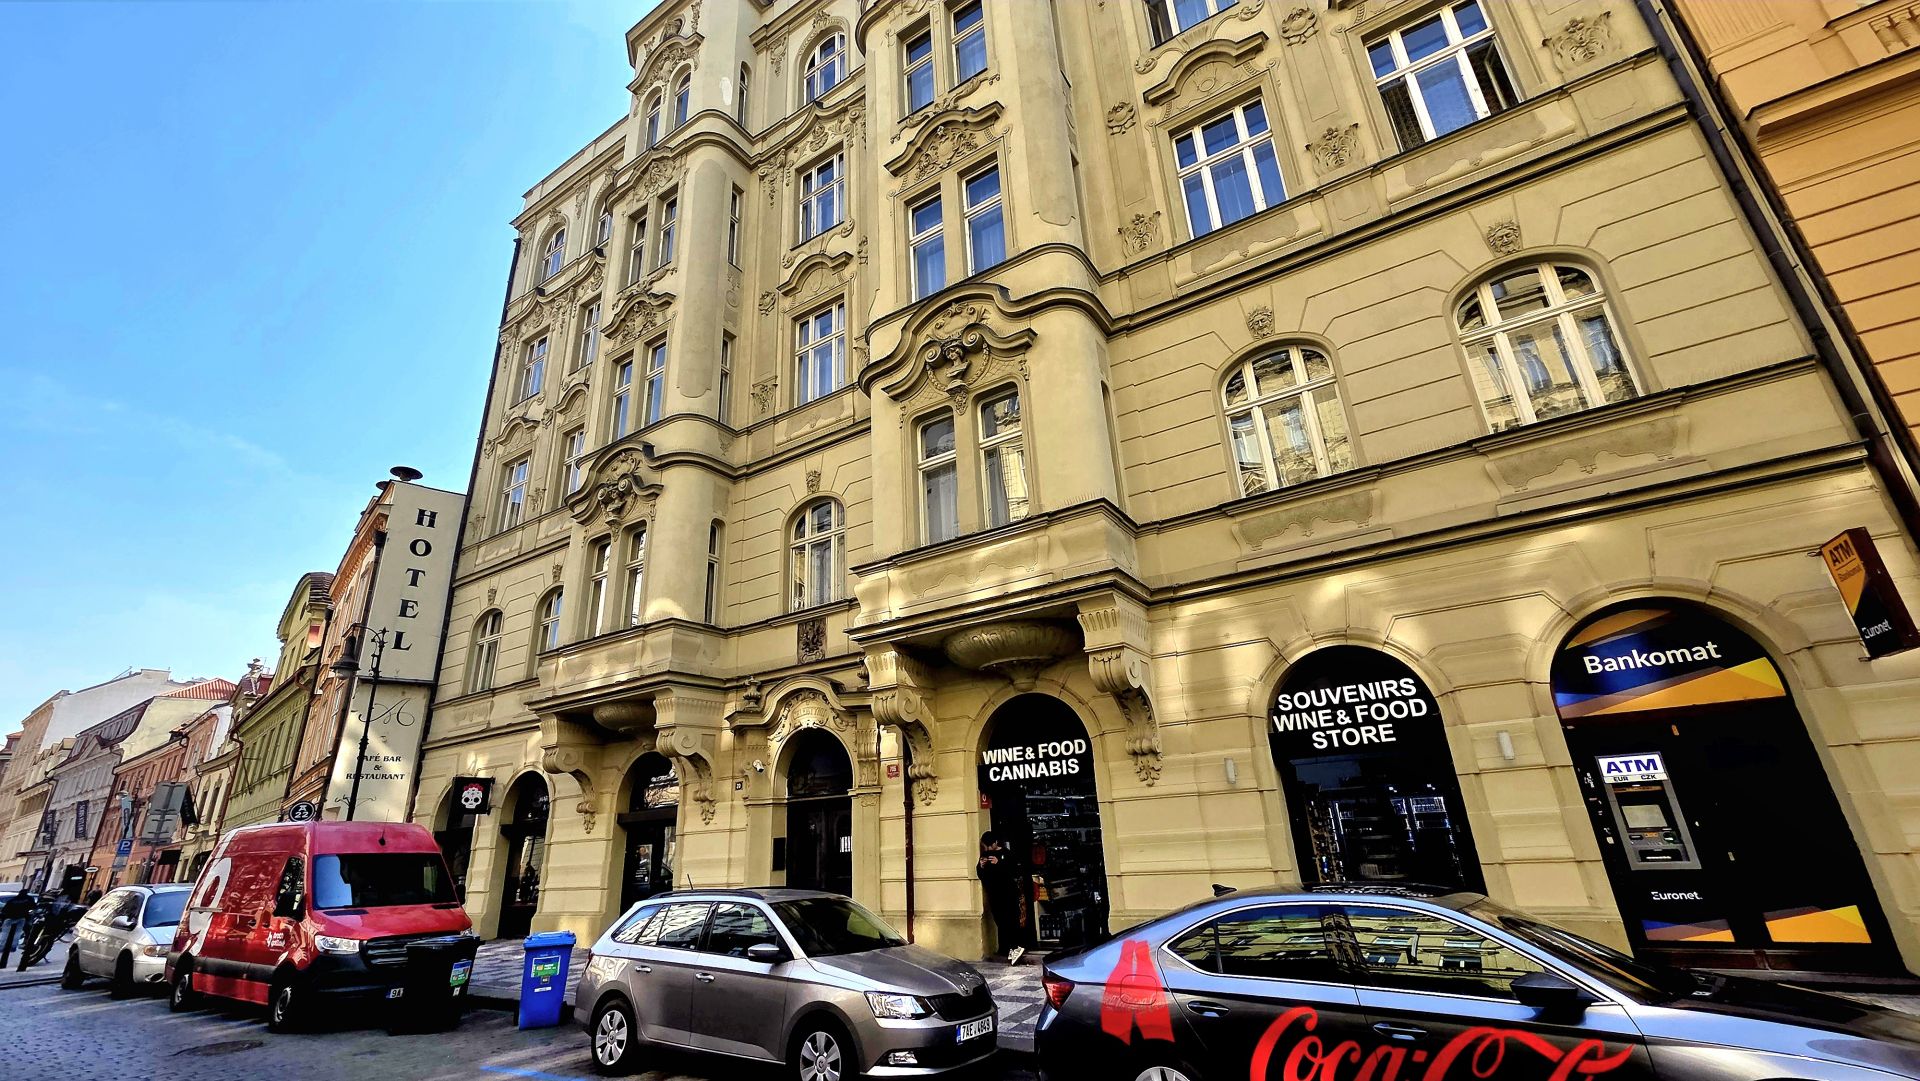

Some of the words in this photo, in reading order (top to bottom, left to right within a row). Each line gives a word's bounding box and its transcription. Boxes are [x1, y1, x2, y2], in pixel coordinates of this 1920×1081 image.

[1829, 540, 1855, 567] ATM
[391, 508, 438, 651] HOTEL
[1862, 619, 1892, 639] Euronet
[1583, 641, 1722, 674] Bankomat
[1278, 678, 1417, 711] SOUVENIRS
[1273, 709, 1334, 732] WINE
[1336, 709, 1352, 726] &
[1355, 698, 1428, 723] FOOD
[1312, 723, 1397, 749] STORE
[983, 746, 1024, 765] WINE
[1025, 746, 1036, 760] &
[1038, 739, 1087, 759] FOOD
[989, 758, 1080, 782] CANNABIS
[1606, 758, 1659, 774] ATM
[962, 1023, 974, 1039] 7AE
